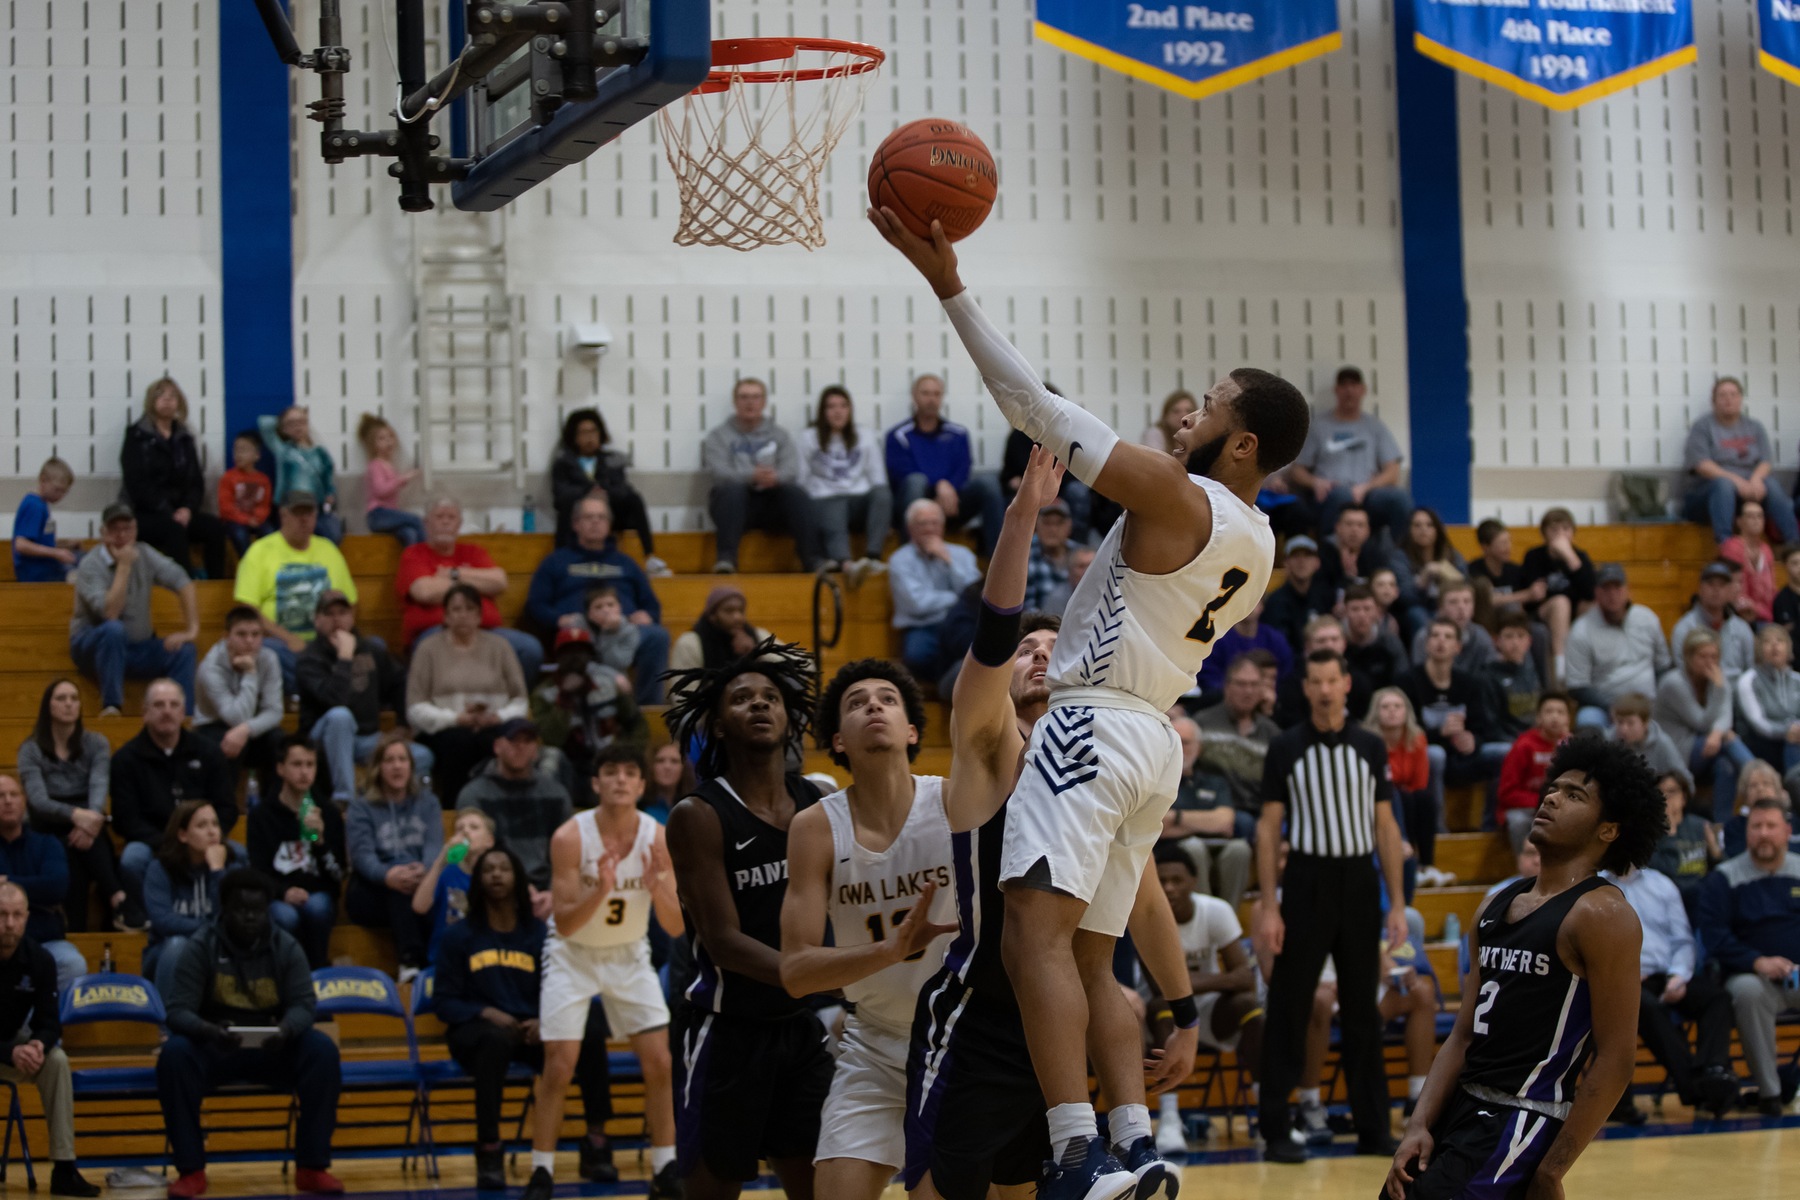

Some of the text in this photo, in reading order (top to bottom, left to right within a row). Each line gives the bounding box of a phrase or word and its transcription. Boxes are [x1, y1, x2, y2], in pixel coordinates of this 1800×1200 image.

[1126, 3, 1255, 32] 2nd Place
[1500, 17, 1612, 47] 4th Place
[1163, 40, 1228, 66] 1992
[1531, 54, 1589, 80] 1994
[1184, 565, 1250, 645] 2
[881, 866, 950, 901] LAKES
[605, 898, 626, 926] 3
[73, 985, 149, 1009] LAKERS
[1473, 980, 1501, 1035] 2
